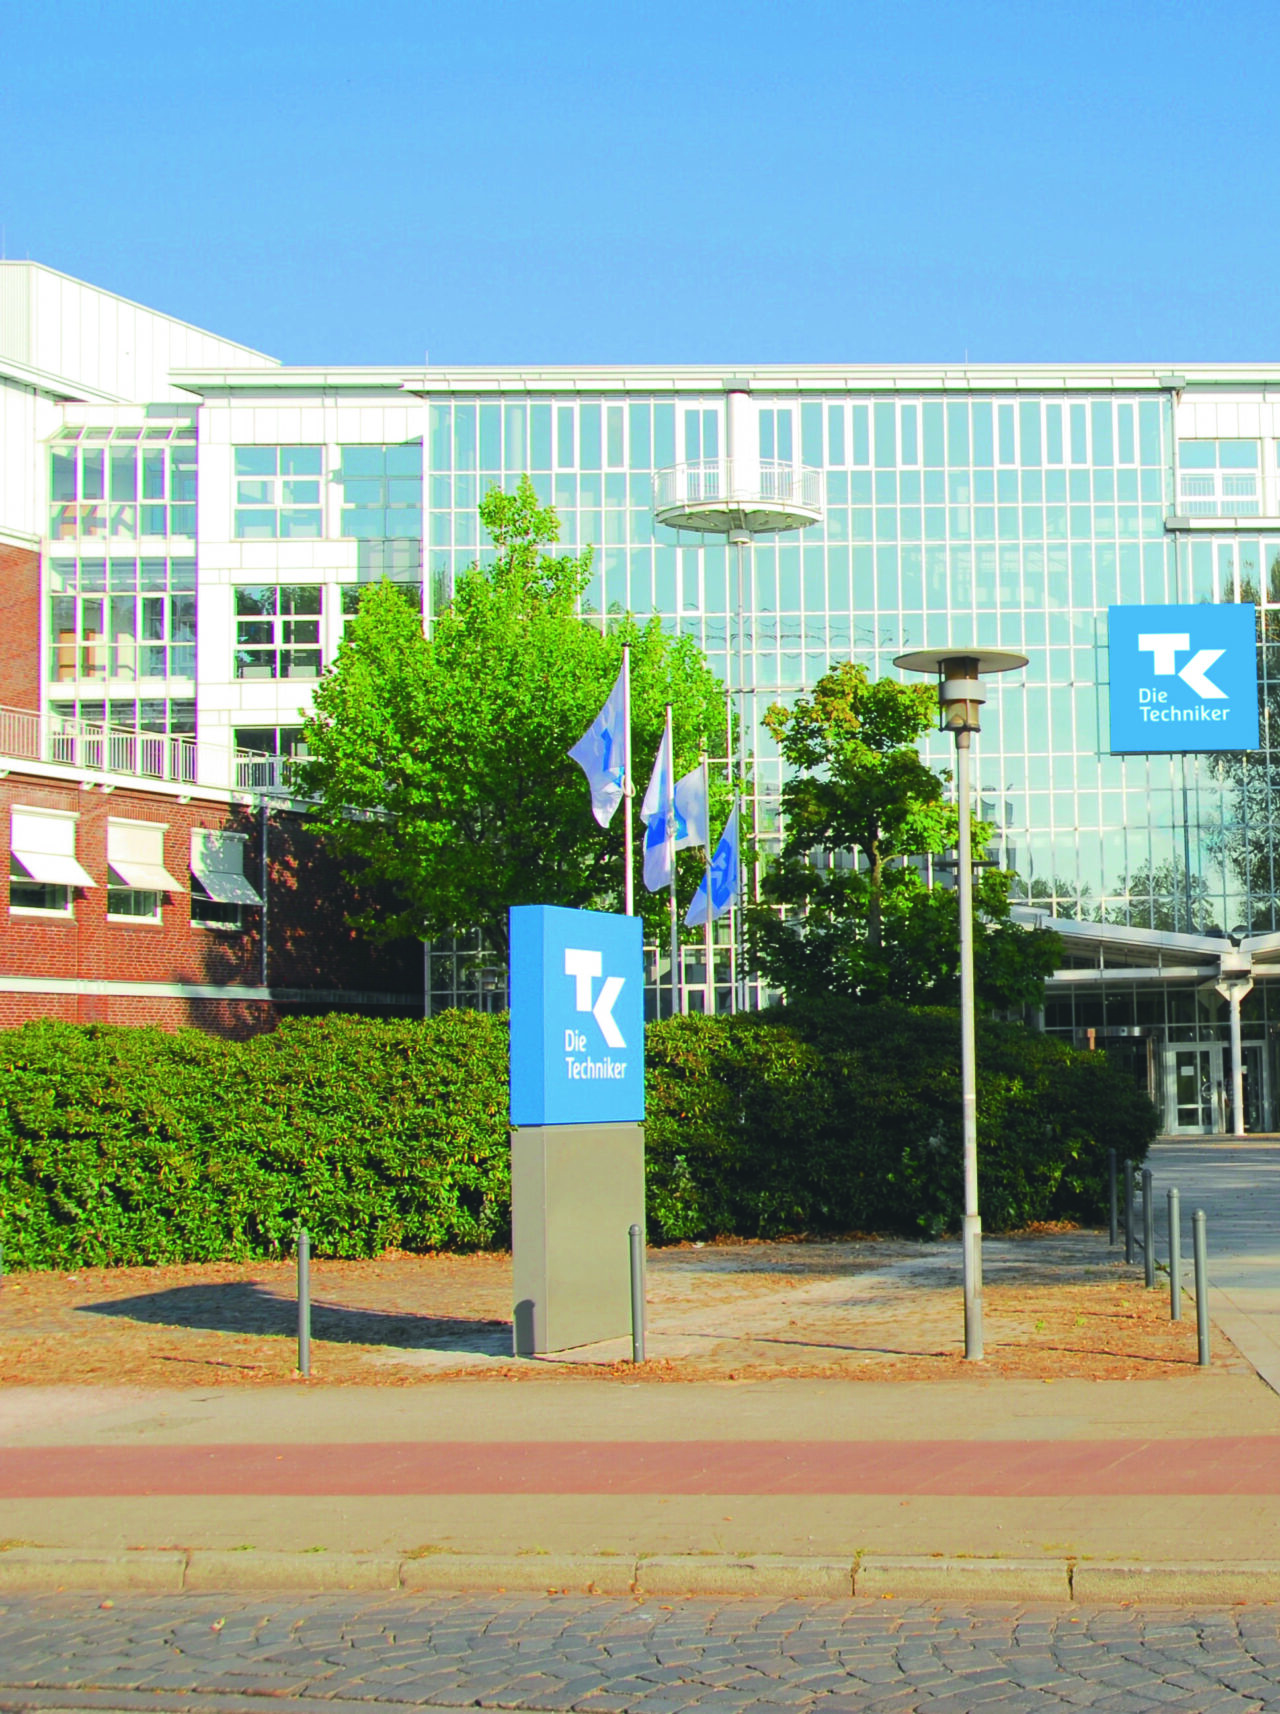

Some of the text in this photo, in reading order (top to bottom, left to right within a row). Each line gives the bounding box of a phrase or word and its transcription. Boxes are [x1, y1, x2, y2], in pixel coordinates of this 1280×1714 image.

[1138, 633, 1230, 699] TK
[1139, 688, 1168, 703] Die
[1139, 705, 1230, 722] Techniker
[565, 948, 627, 1048] TK
[565, 1030, 587, 1052] Die
[565, 1057, 627, 1080] Techniker
